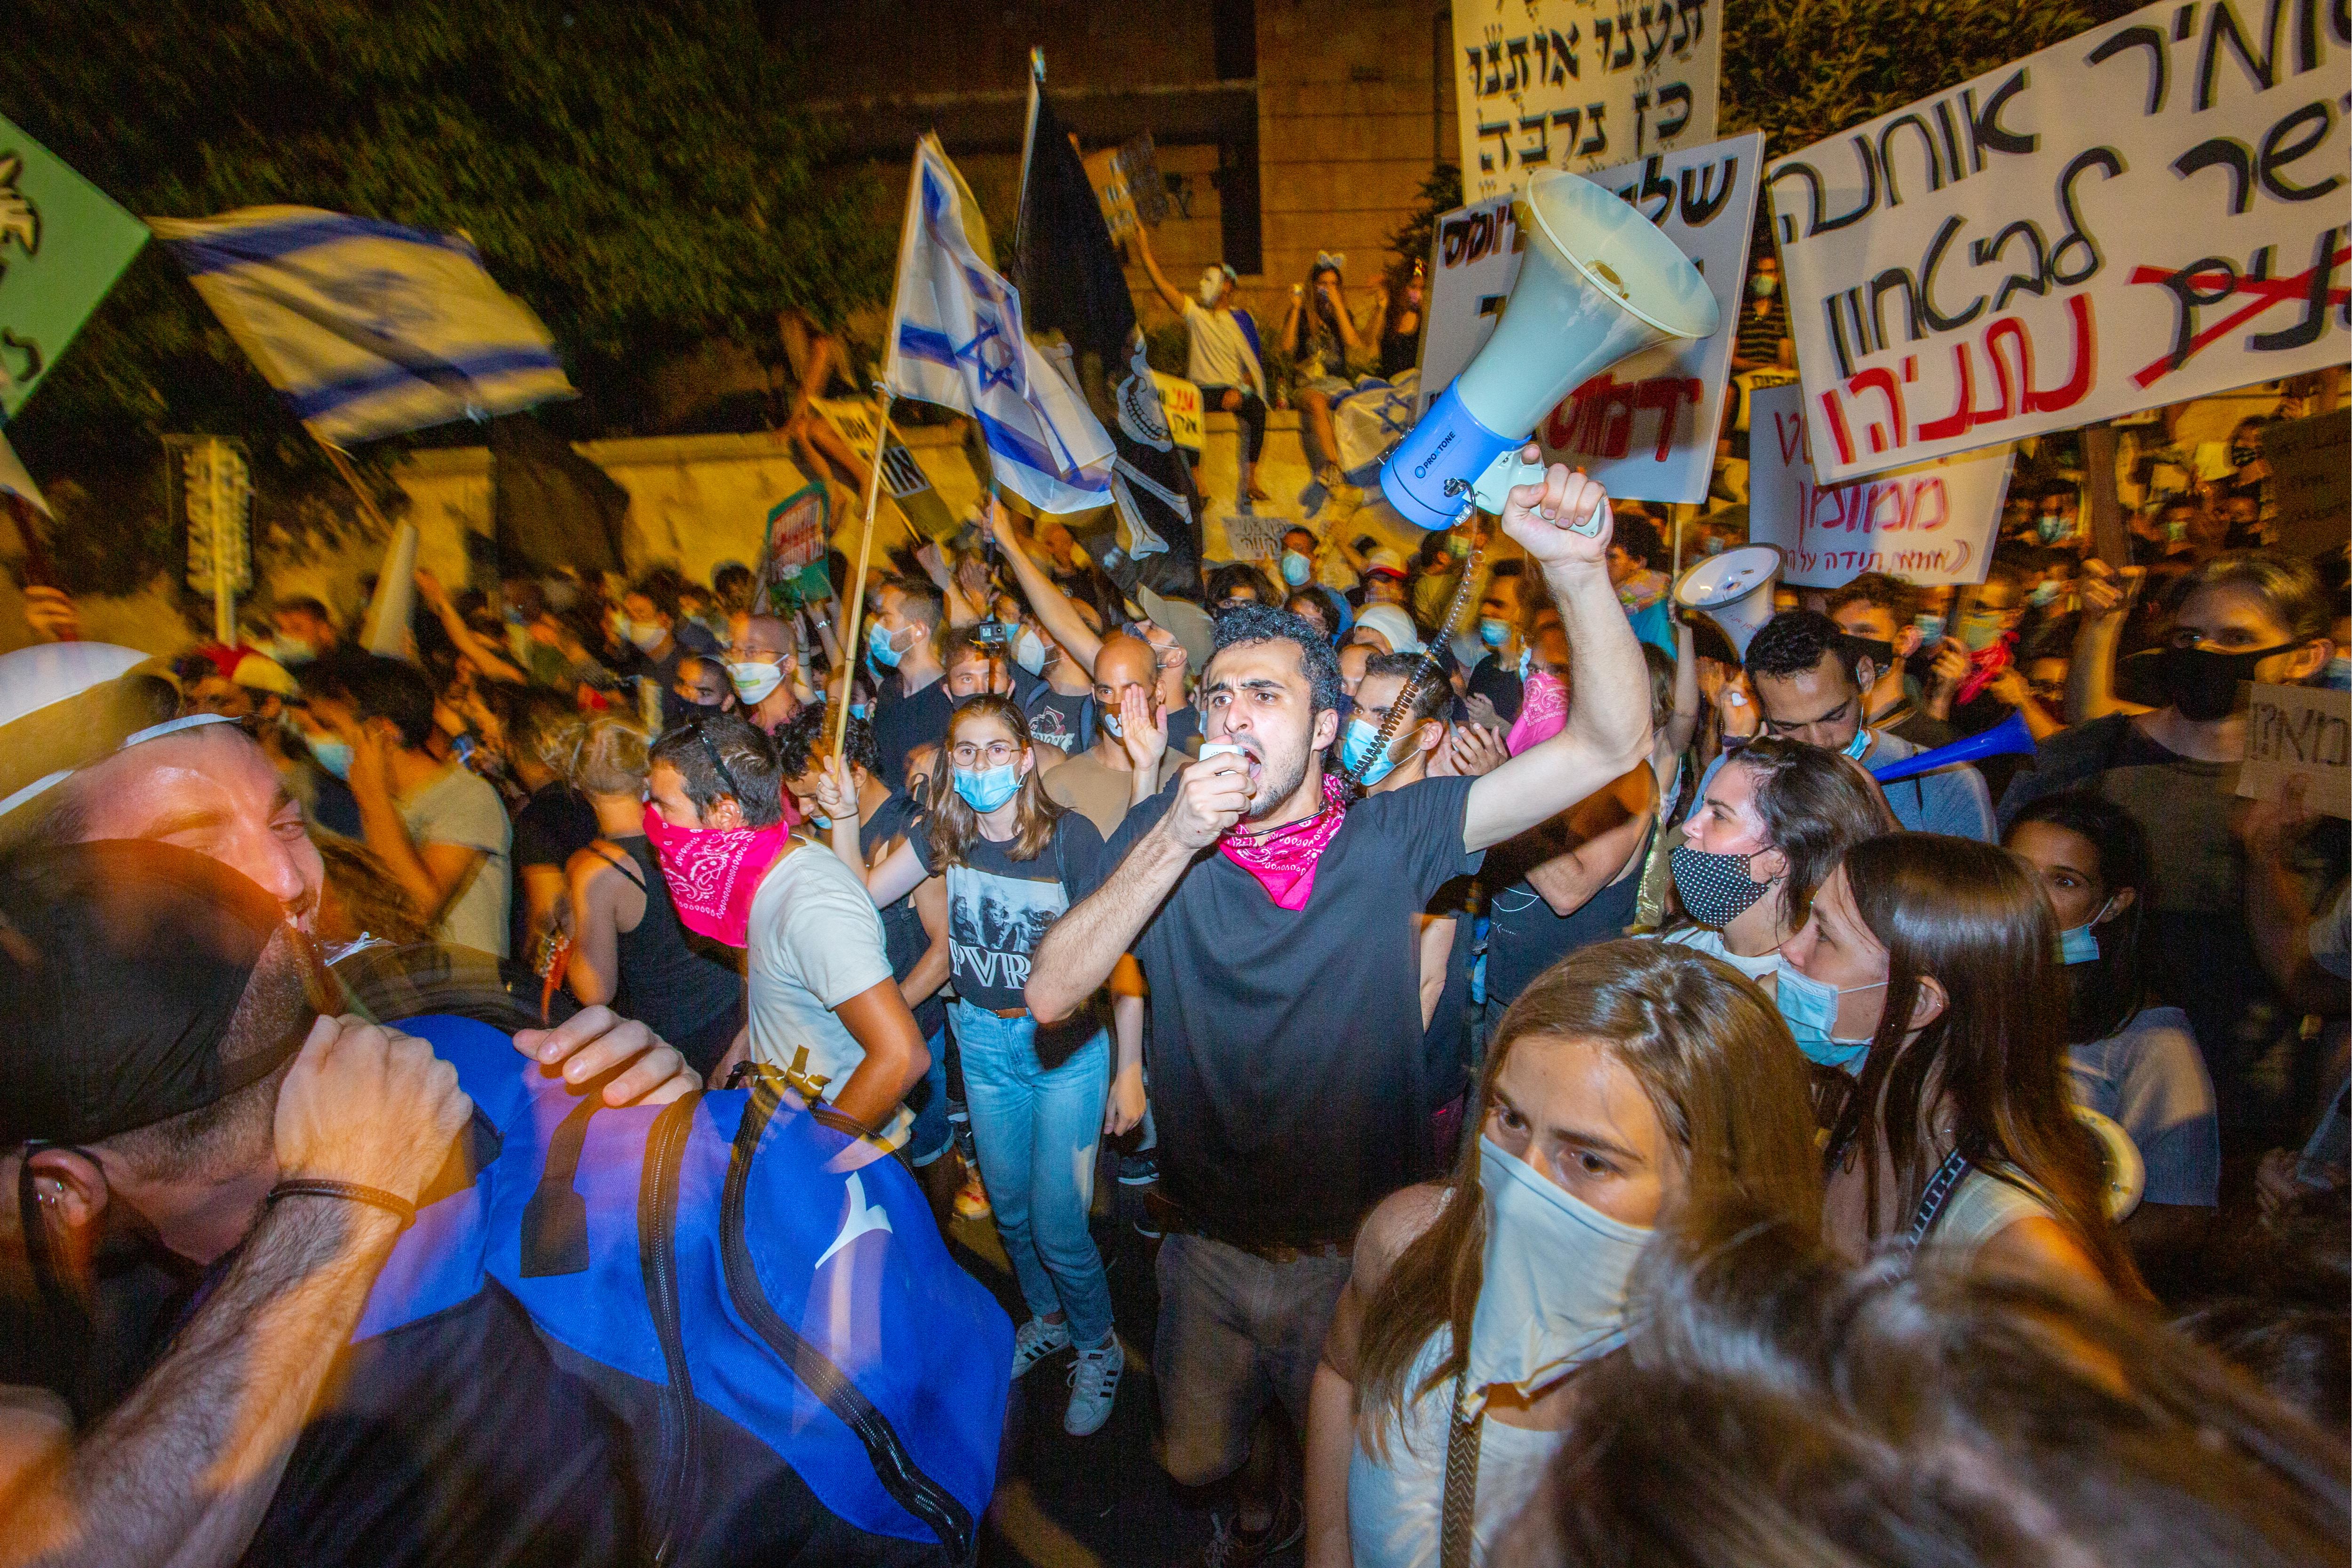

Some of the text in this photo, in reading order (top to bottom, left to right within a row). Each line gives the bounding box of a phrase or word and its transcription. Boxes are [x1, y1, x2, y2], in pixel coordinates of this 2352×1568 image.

[1767, 67, 2040, 245] אוחנה
[1822, 92, 2352, 379] שר לביטחון
[1817, 226, 2352, 466] נים נתניהו
